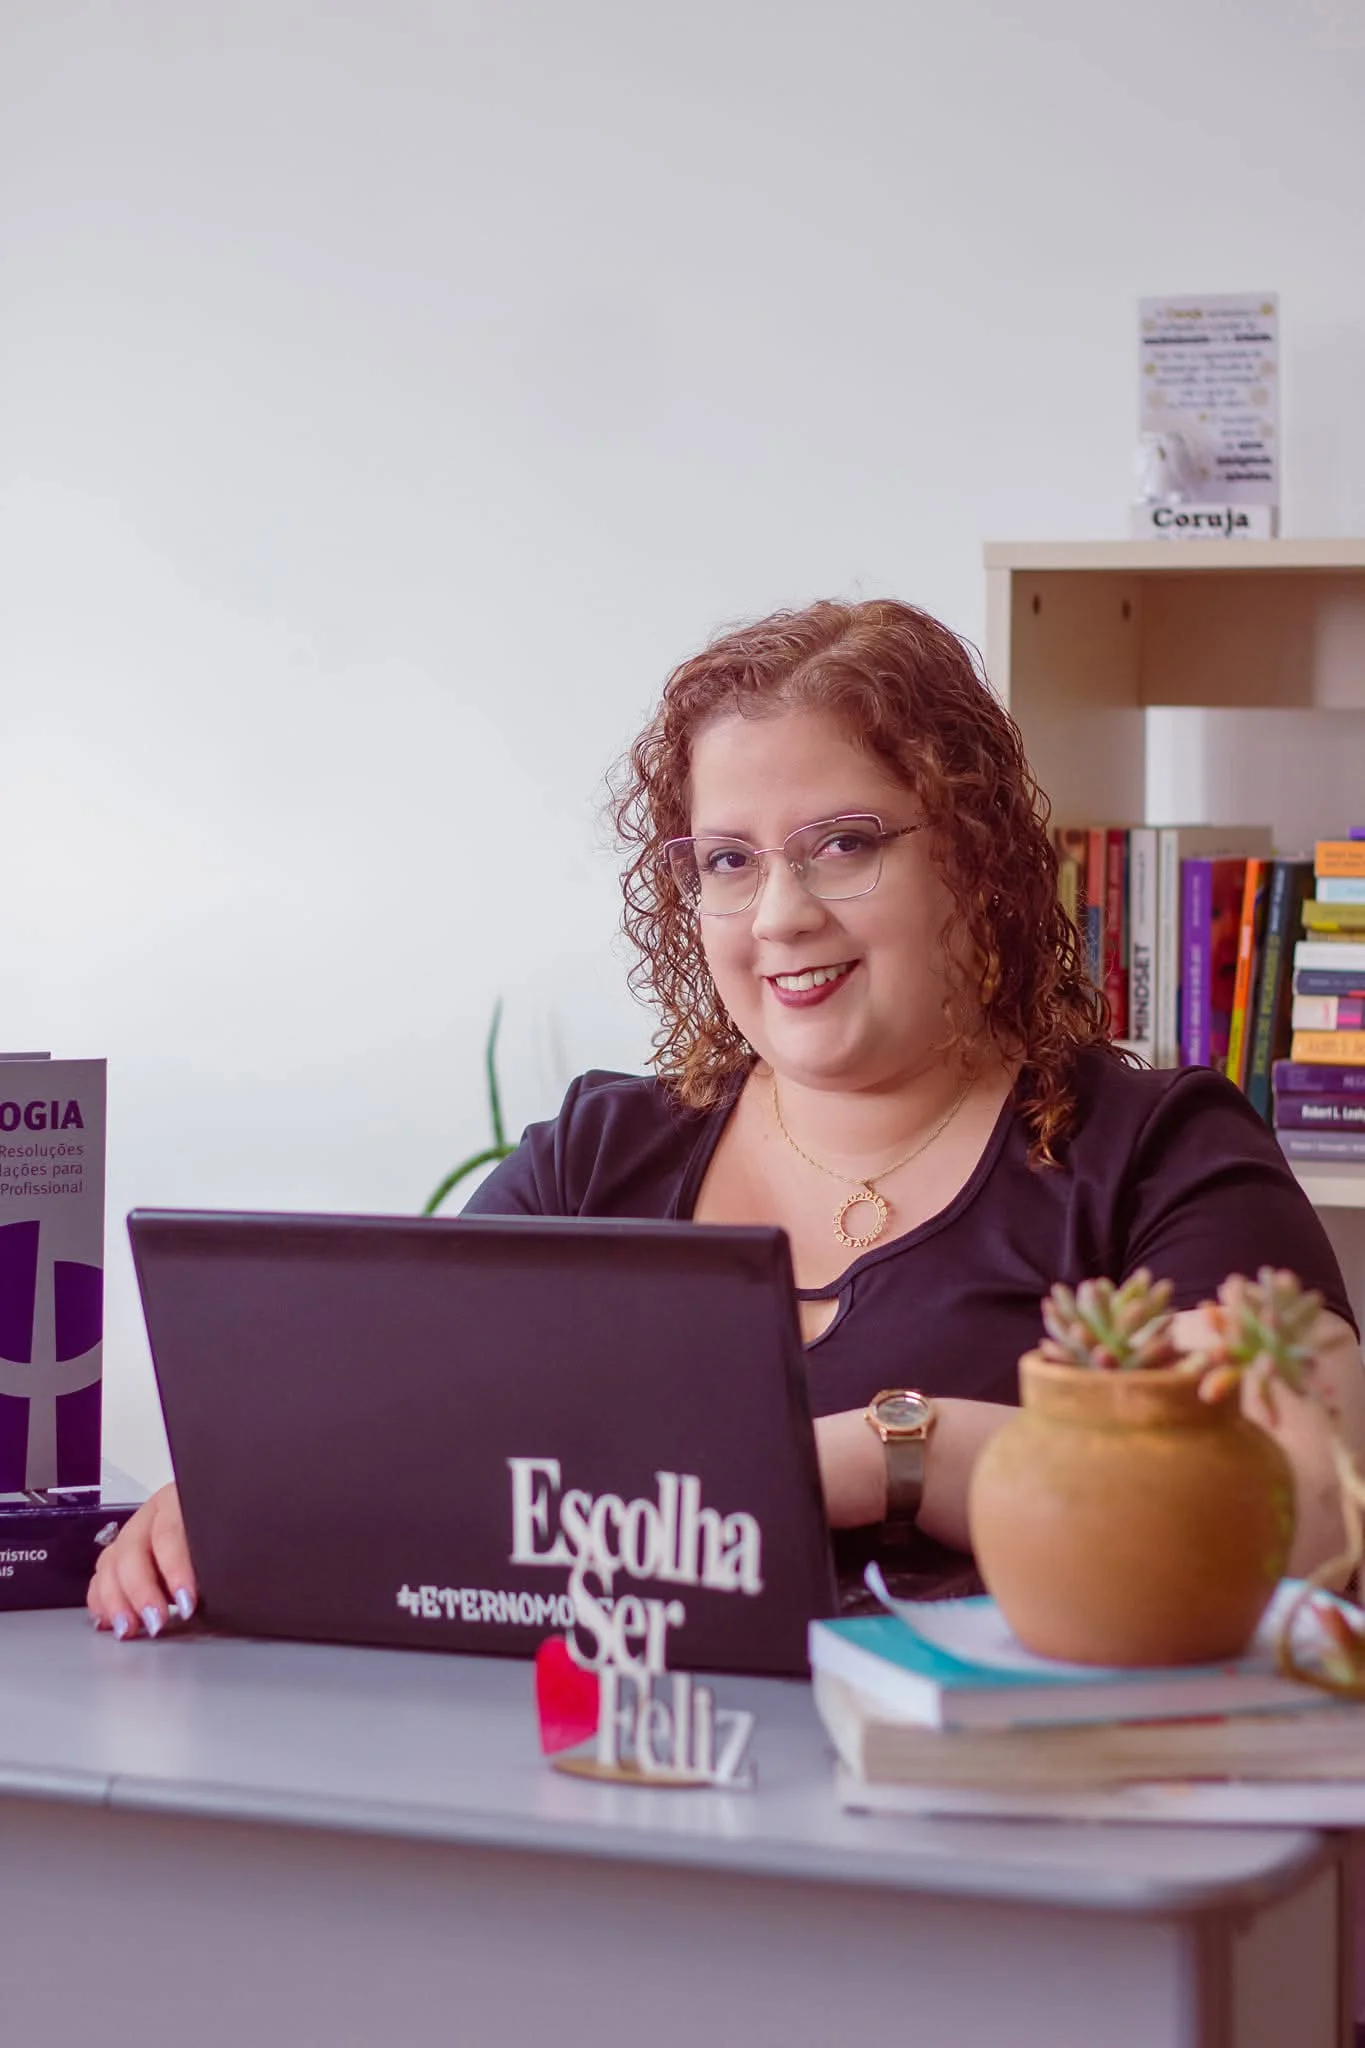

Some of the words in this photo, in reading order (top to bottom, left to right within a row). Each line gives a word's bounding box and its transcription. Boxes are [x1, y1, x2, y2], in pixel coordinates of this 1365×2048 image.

[1152, 508, 1250, 534] Coruja
[0, 1100, 84, 1132] OGIA
[0, 1143, 84, 1159] Resoluções
[53, 1164, 83, 1178] para
[1, 1180, 83, 1196] Profissional
[506, 1456, 764, 1597] Escolha
[564, 1562, 686, 1677] Ser
[597, 1664, 756, 1787] Feliz
